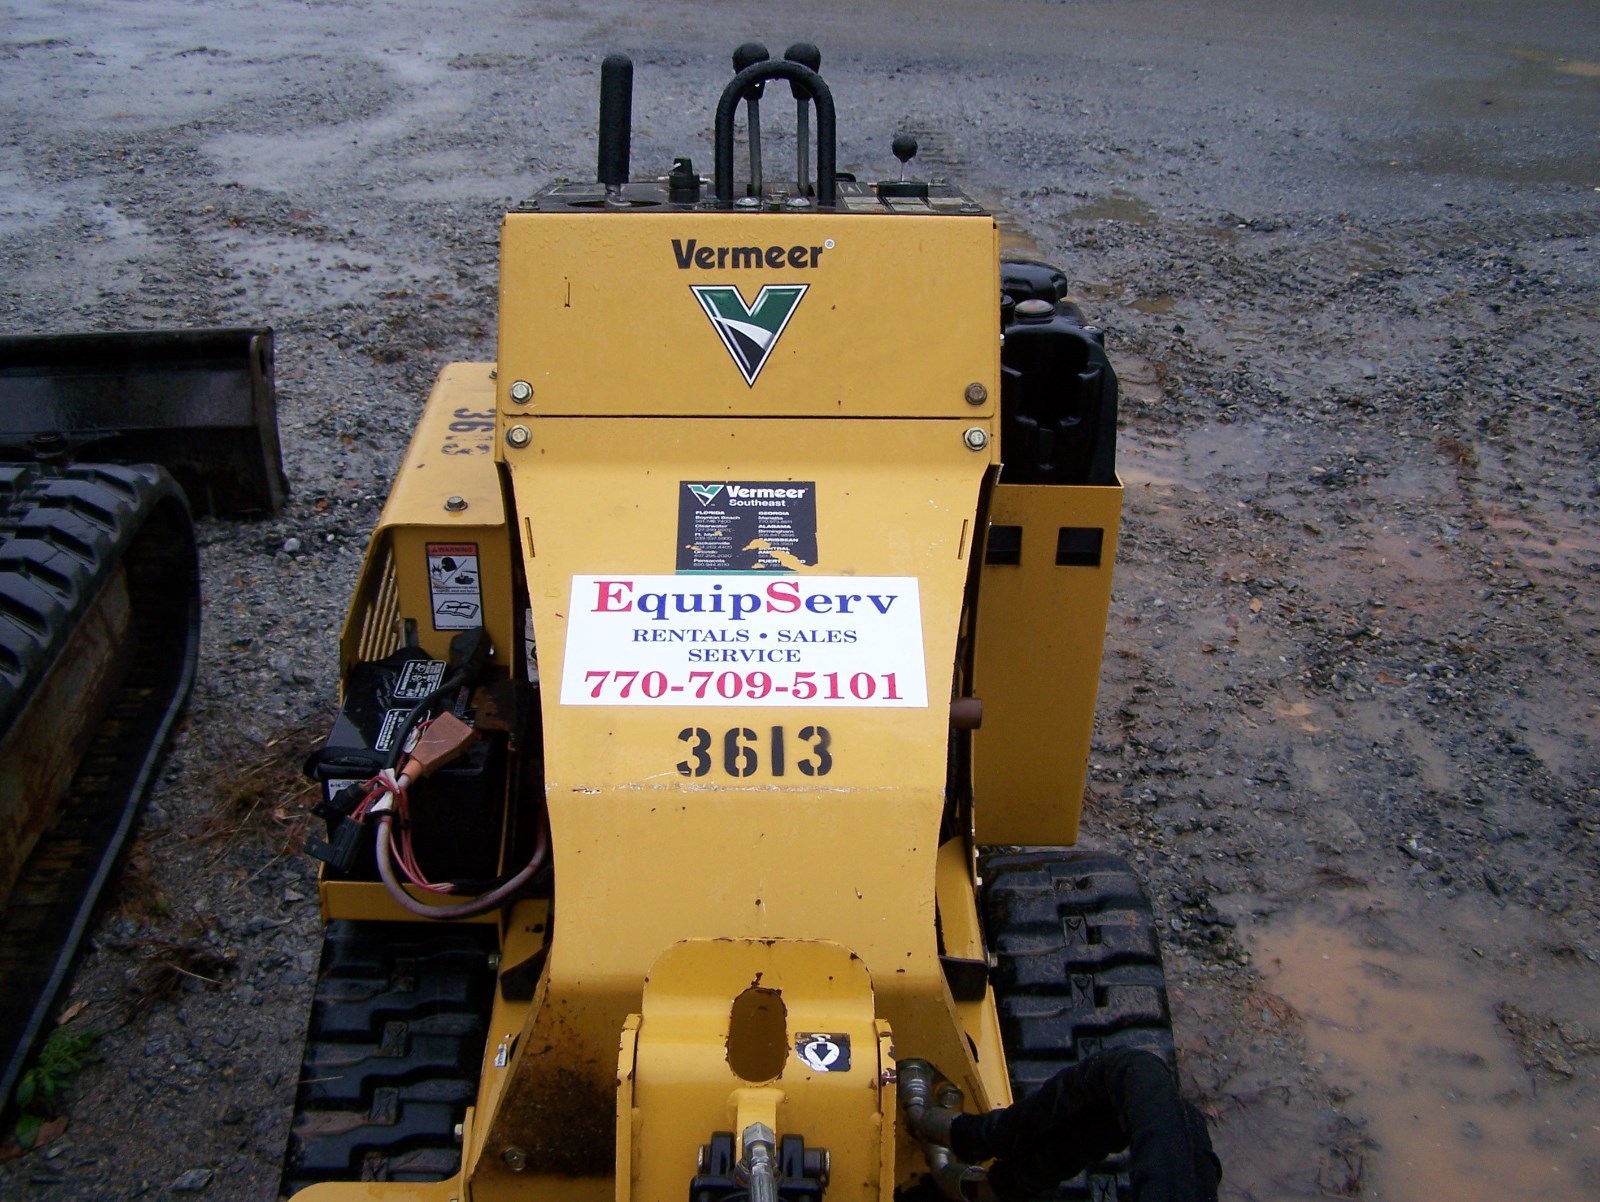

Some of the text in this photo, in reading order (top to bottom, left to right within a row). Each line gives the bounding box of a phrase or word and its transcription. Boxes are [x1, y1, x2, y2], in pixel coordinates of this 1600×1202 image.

[671, 239, 823, 269] Vermeer
[726, 485, 806, 498] Vermeer
[729, 499, 786, 507] Southeast
[590, 580, 898, 620] EquipServ
[632, 628, 857, 644] RENTALS SALES
[688, 648, 801, 663] SERVICE
[584, 671, 903, 700] 770-709-5101
[676, 725, 833, 778] 3613
